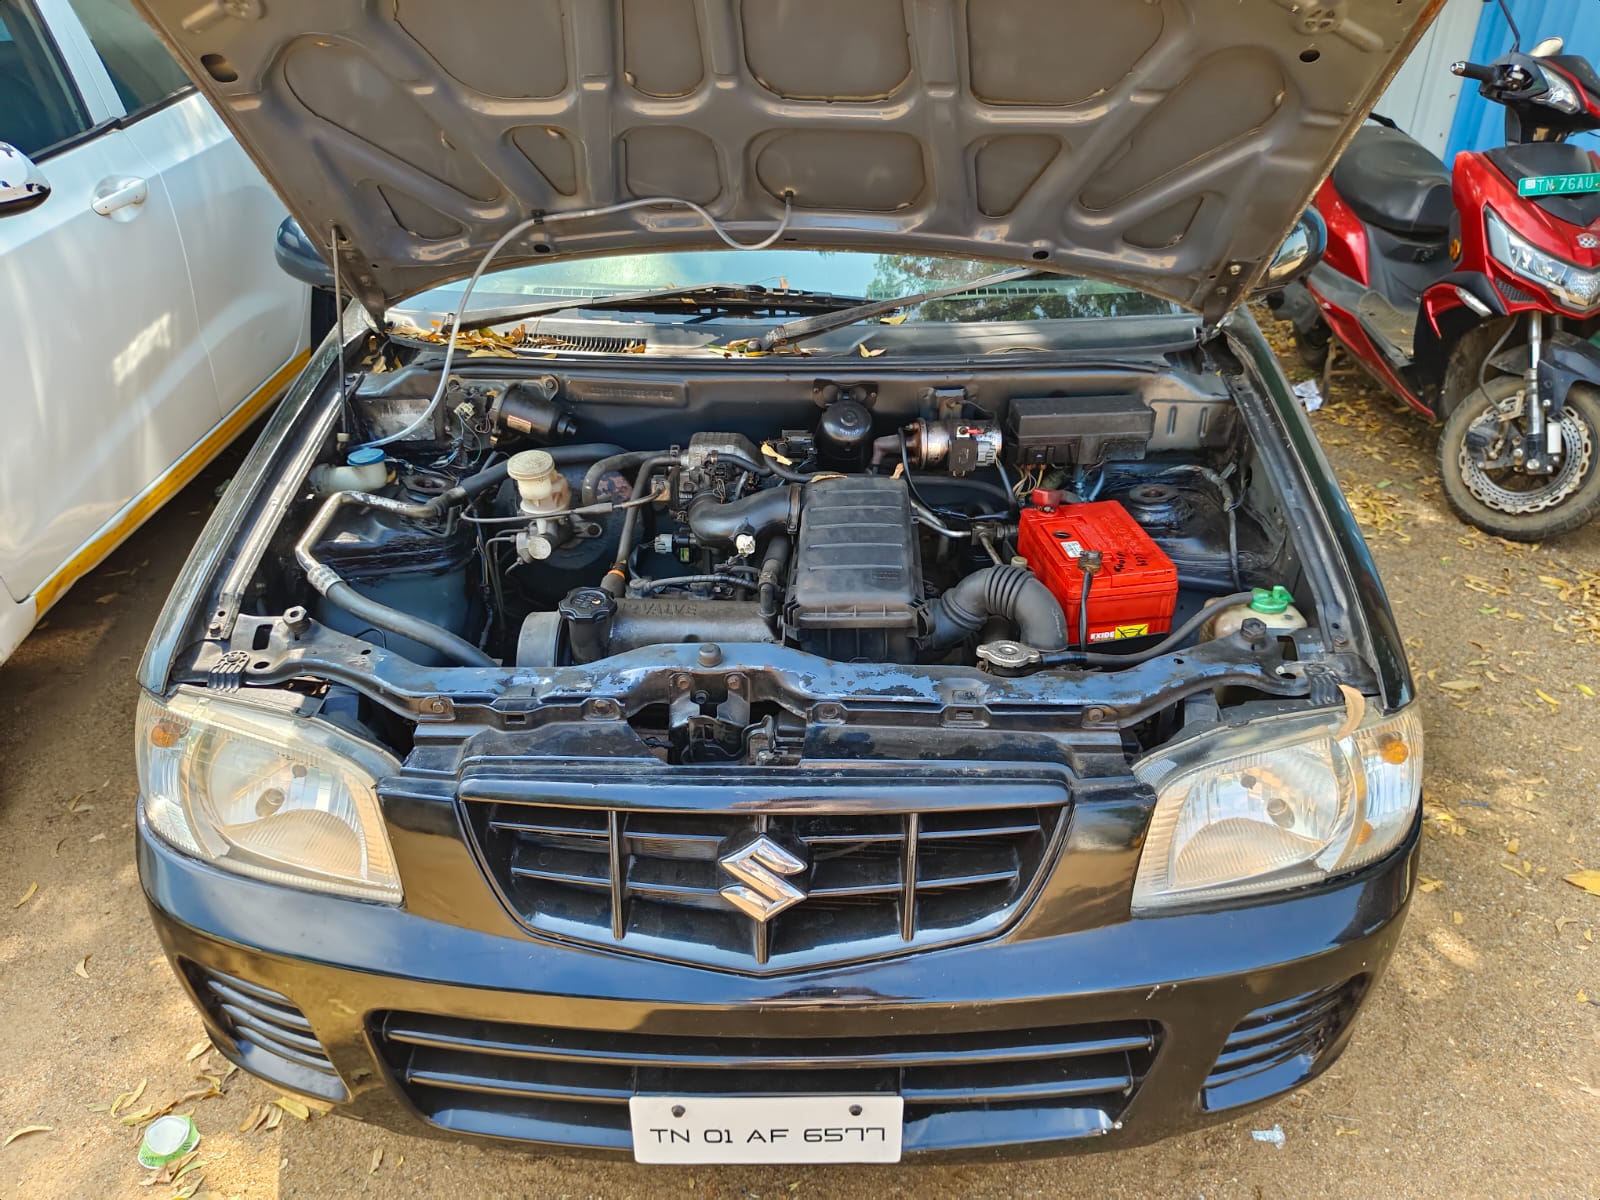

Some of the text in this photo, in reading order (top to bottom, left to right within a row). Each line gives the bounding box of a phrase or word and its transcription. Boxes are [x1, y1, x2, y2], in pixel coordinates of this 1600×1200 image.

[1536, 176, 1594, 192] TN 76AU
[643, 602, 697, 617] VALVE
[1090, 631, 1115, 640] EXIDE
[650, 1127, 885, 1143] TN 01 AF 6577
